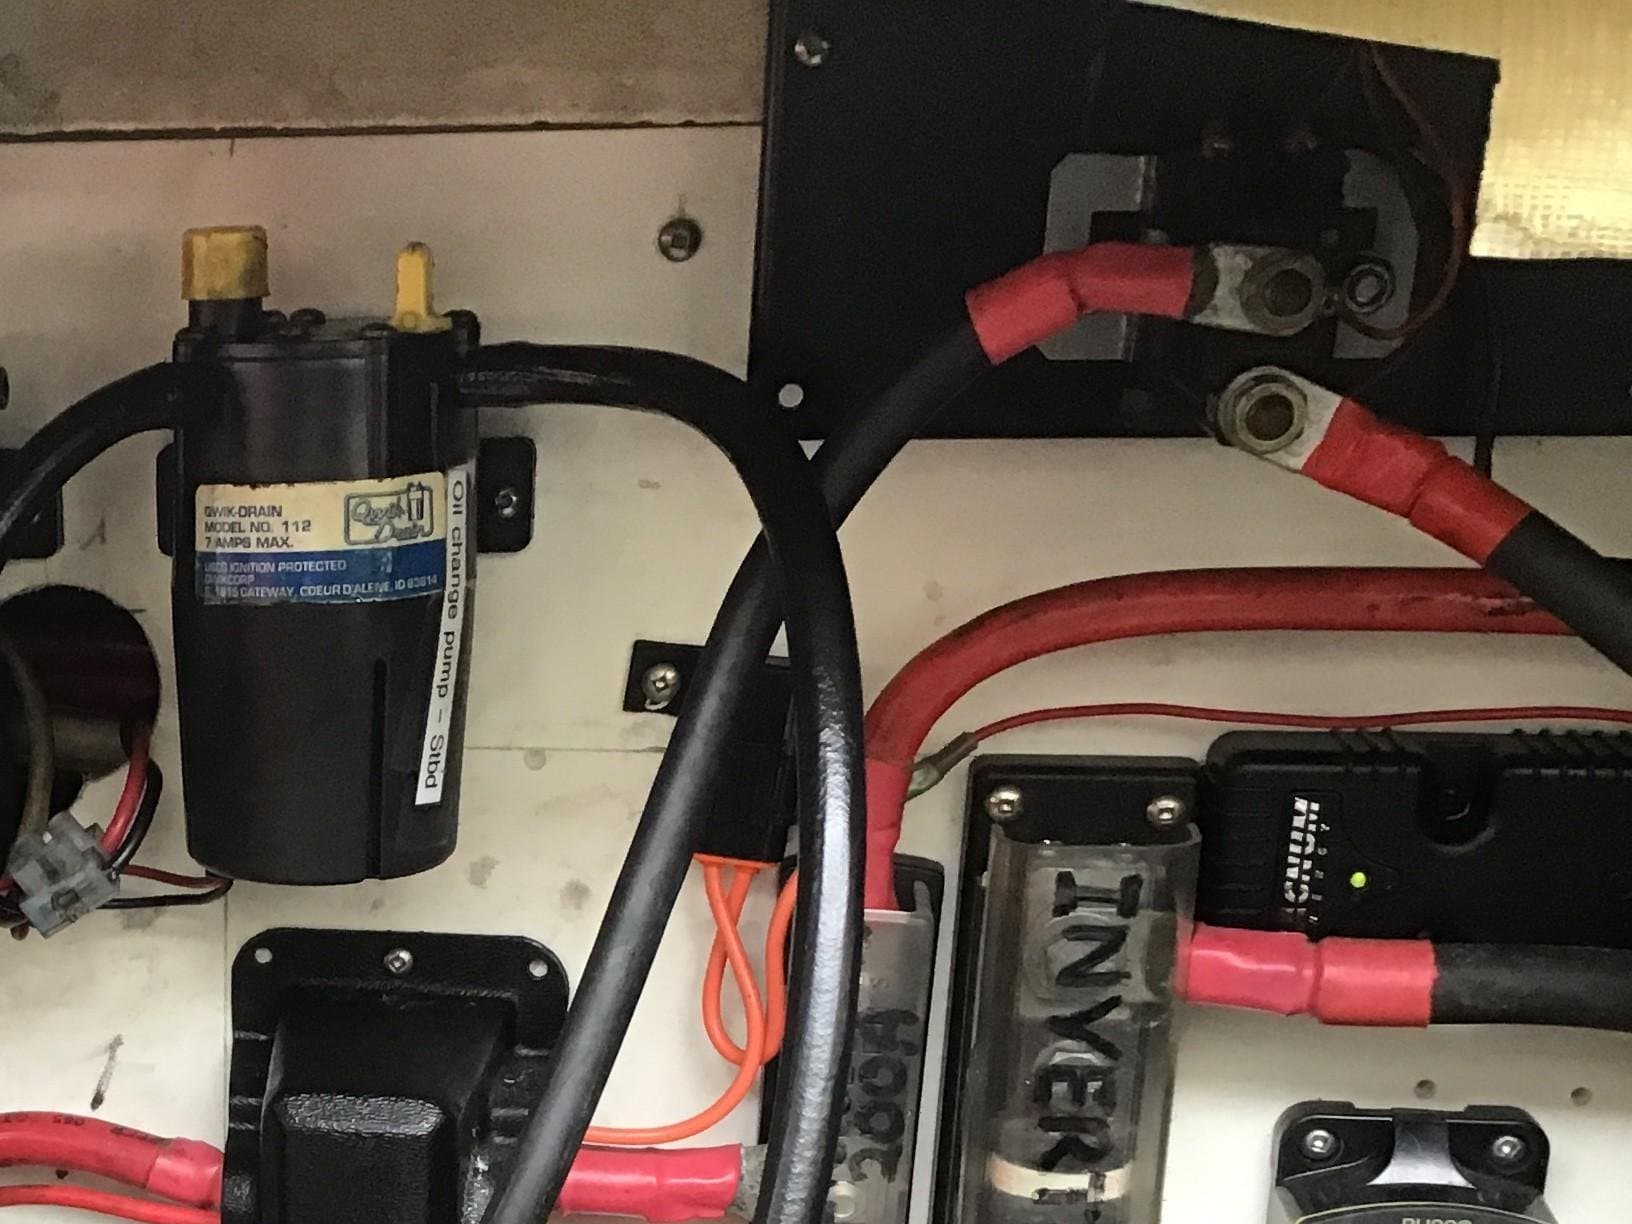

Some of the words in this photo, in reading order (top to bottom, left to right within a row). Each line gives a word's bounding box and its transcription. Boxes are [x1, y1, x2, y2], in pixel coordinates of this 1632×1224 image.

[452, 480, 464, 515] Oil
[205, 521, 245, 533] MODEL
[282, 520, 311, 533] 112
[205, 537, 212, 548] 7
[215, 537, 251, 549] AMPS
[277, 560, 347, 572] PROTECTED
[448, 525, 464, 620] change
[299, 584, 342, 597] COEUR
[436, 631, 456, 698] pump
[424, 735, 445, 789] Stbd
